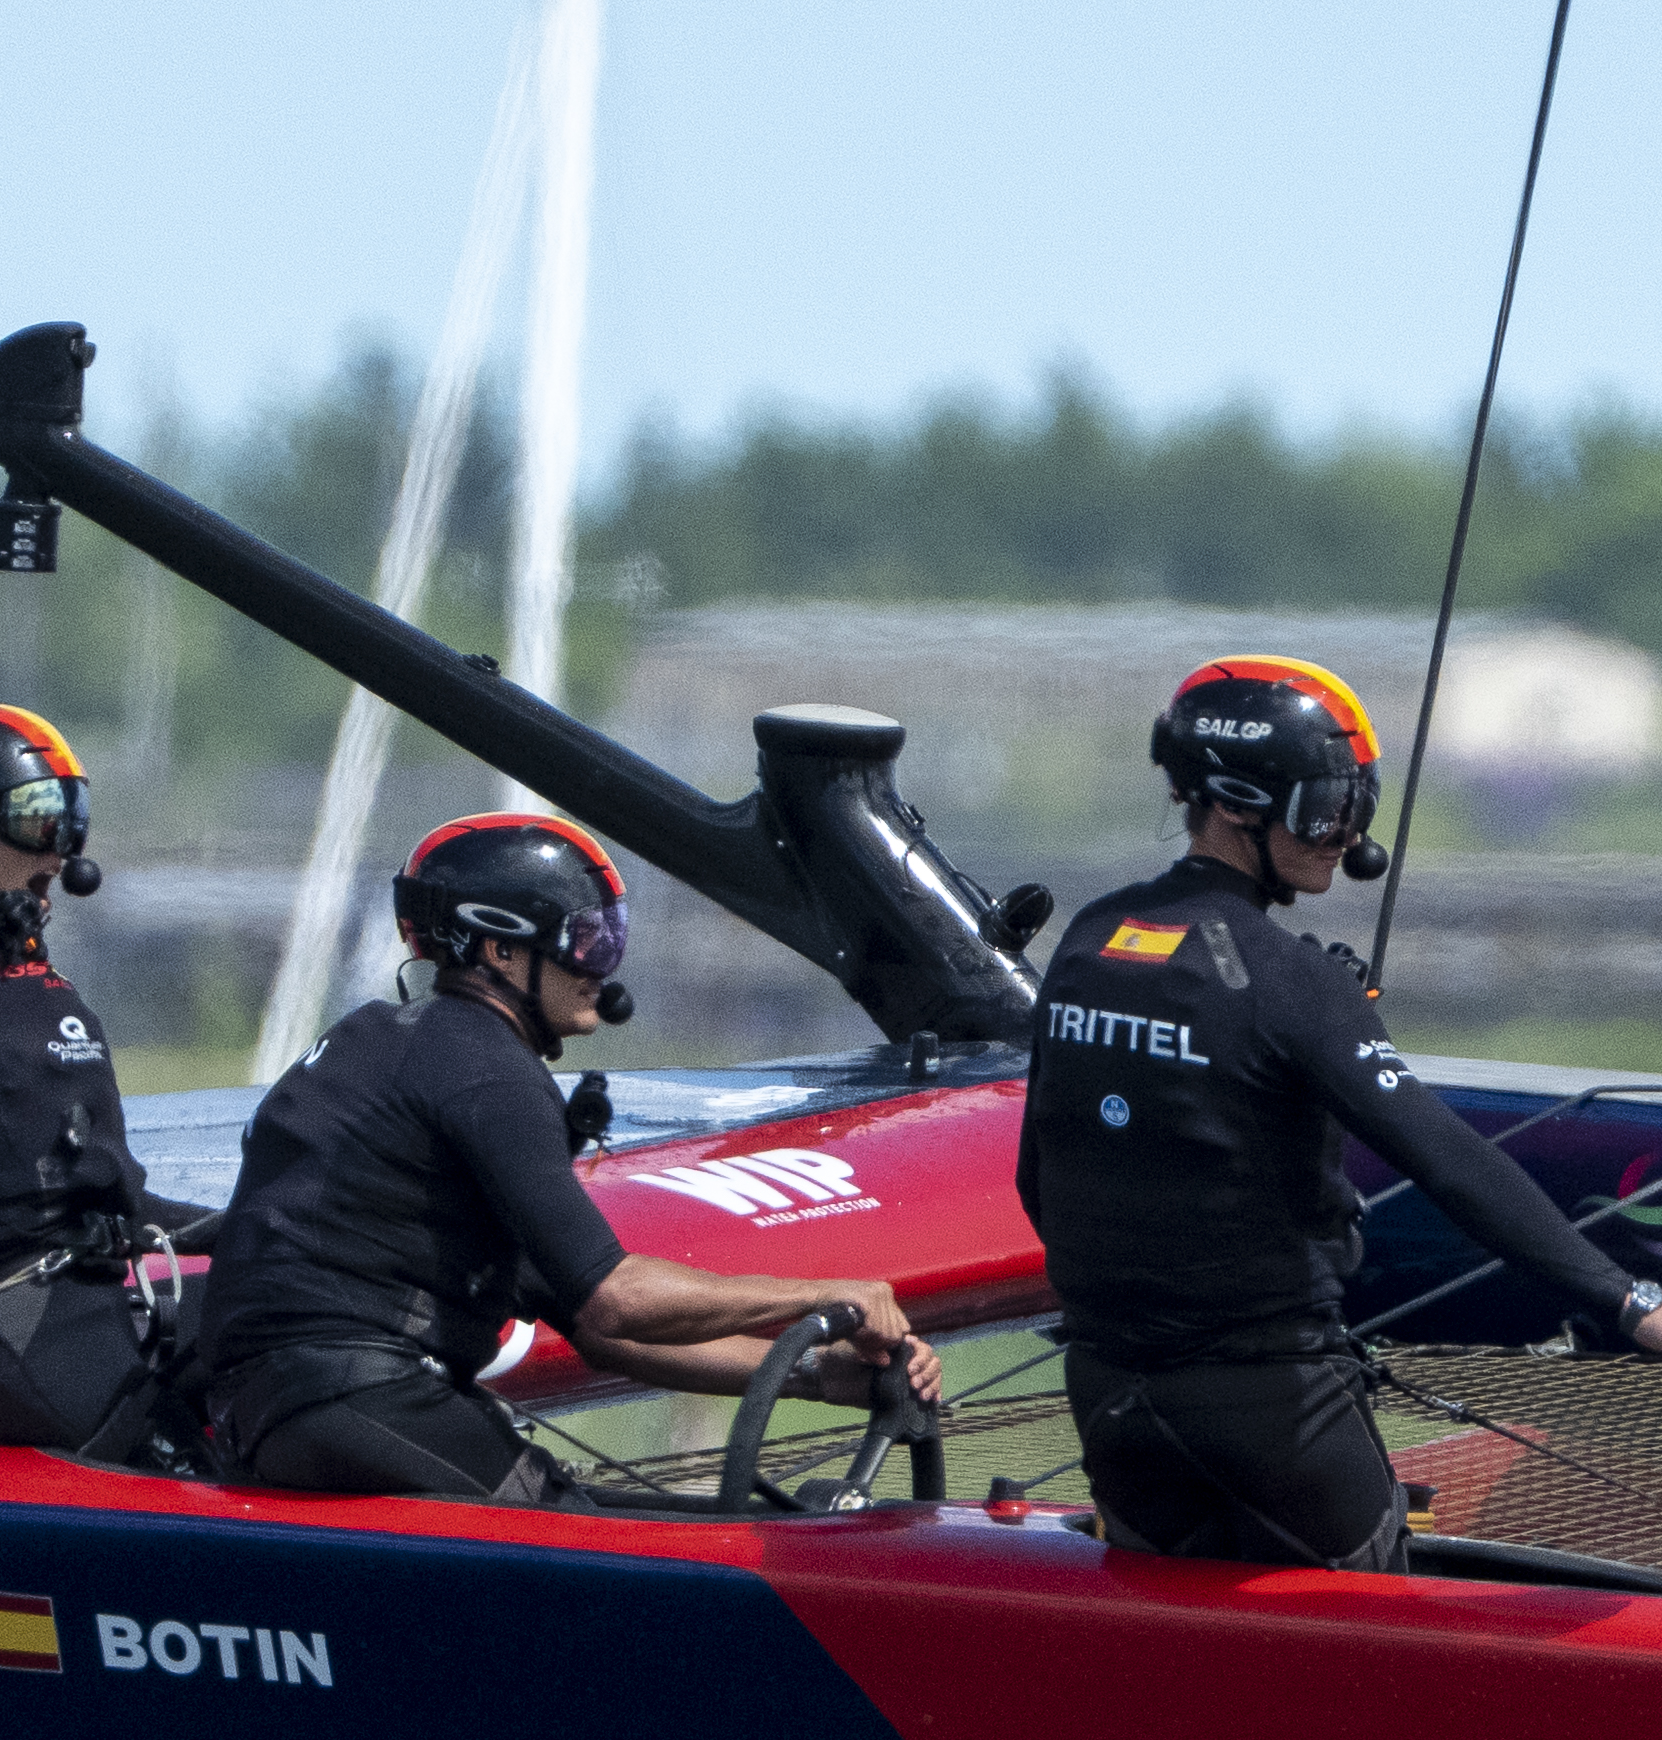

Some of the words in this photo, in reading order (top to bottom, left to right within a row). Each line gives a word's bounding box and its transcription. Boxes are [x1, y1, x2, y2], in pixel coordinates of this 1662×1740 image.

[1194, 717, 1273, 739] SAILGP
[1049, 1002, 1211, 1067] TRITTEL
[626, 1147, 862, 1216] WIP
[750, 1210, 800, 1229] WATER
[799, 1196, 882, 1221] PROTECTION
[96, 1612, 334, 1688] BOTIN
